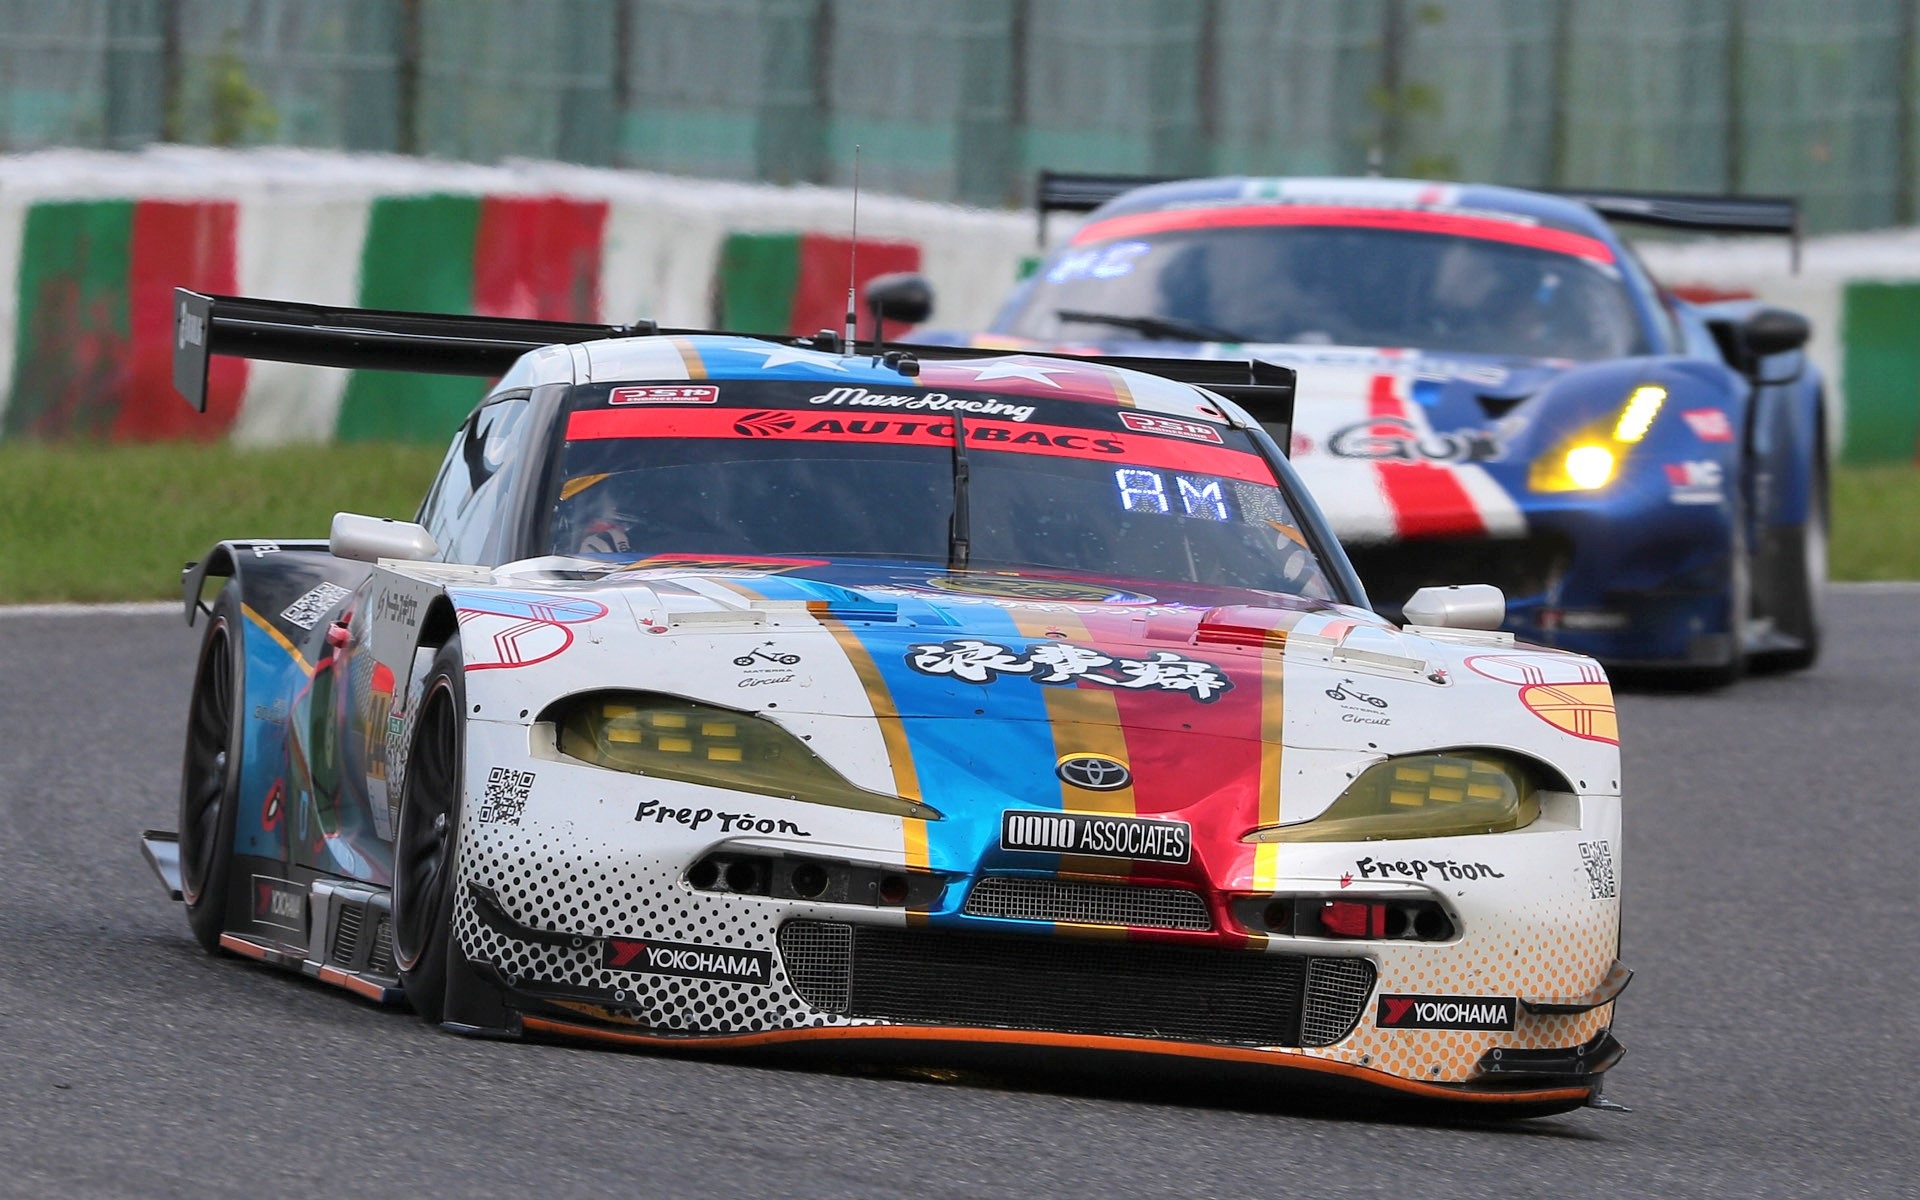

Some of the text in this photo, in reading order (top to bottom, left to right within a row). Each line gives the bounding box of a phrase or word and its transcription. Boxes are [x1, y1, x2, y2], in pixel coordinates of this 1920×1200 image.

[906, 392, 1036, 423] Racing
[801, 419, 1125, 453] AUTOBACS
[737, 674, 796, 688] Circuit
[1342, 713, 1392, 726] Circuit
[1079, 820, 1185, 857] ASSOCIATES
[646, 946, 762, 978] YOKOHAMA
[1414, 1002, 1508, 1024] YOKOHAMA
